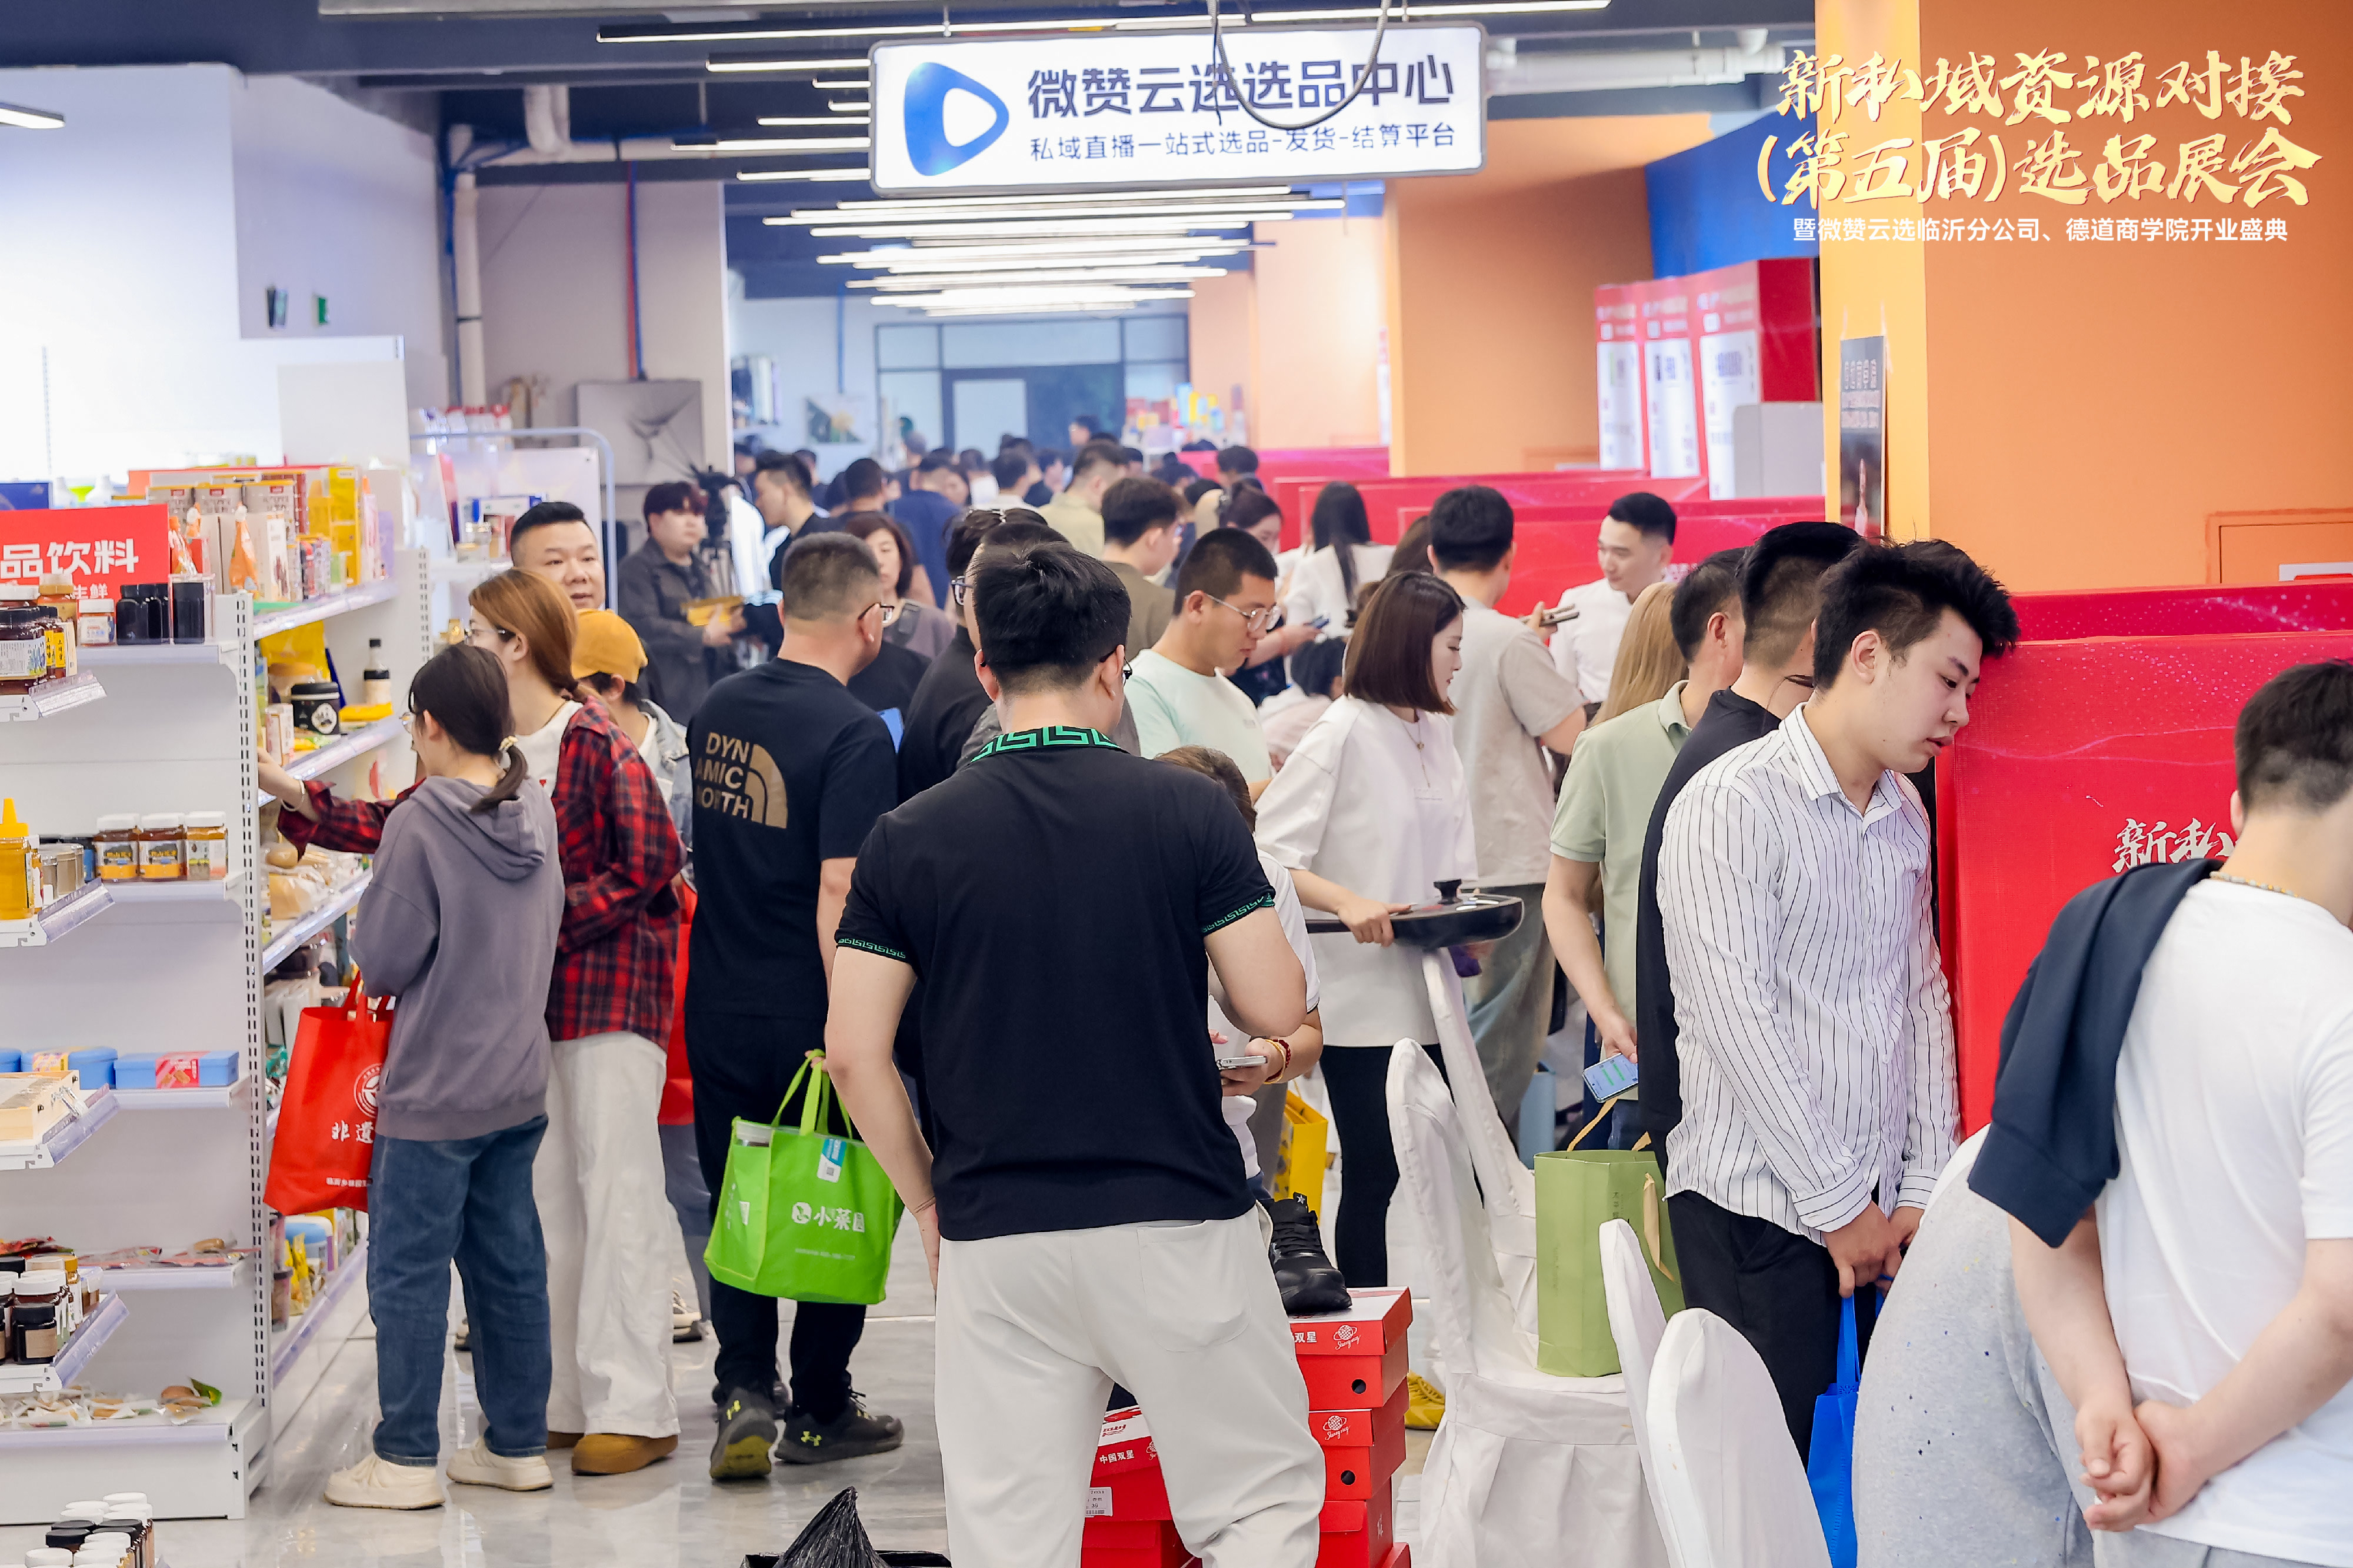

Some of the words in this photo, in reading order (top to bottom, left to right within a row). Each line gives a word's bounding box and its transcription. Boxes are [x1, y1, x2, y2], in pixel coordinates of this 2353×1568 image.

[1028, 54, 1455, 119] 微赞云选选品中心
[1, 538, 139, 579] 品饮料
[706, 732, 750, 763] DYN
[695, 757, 744, 789] AMIC
[1099, 1449, 1135, 1464] 中国双星
